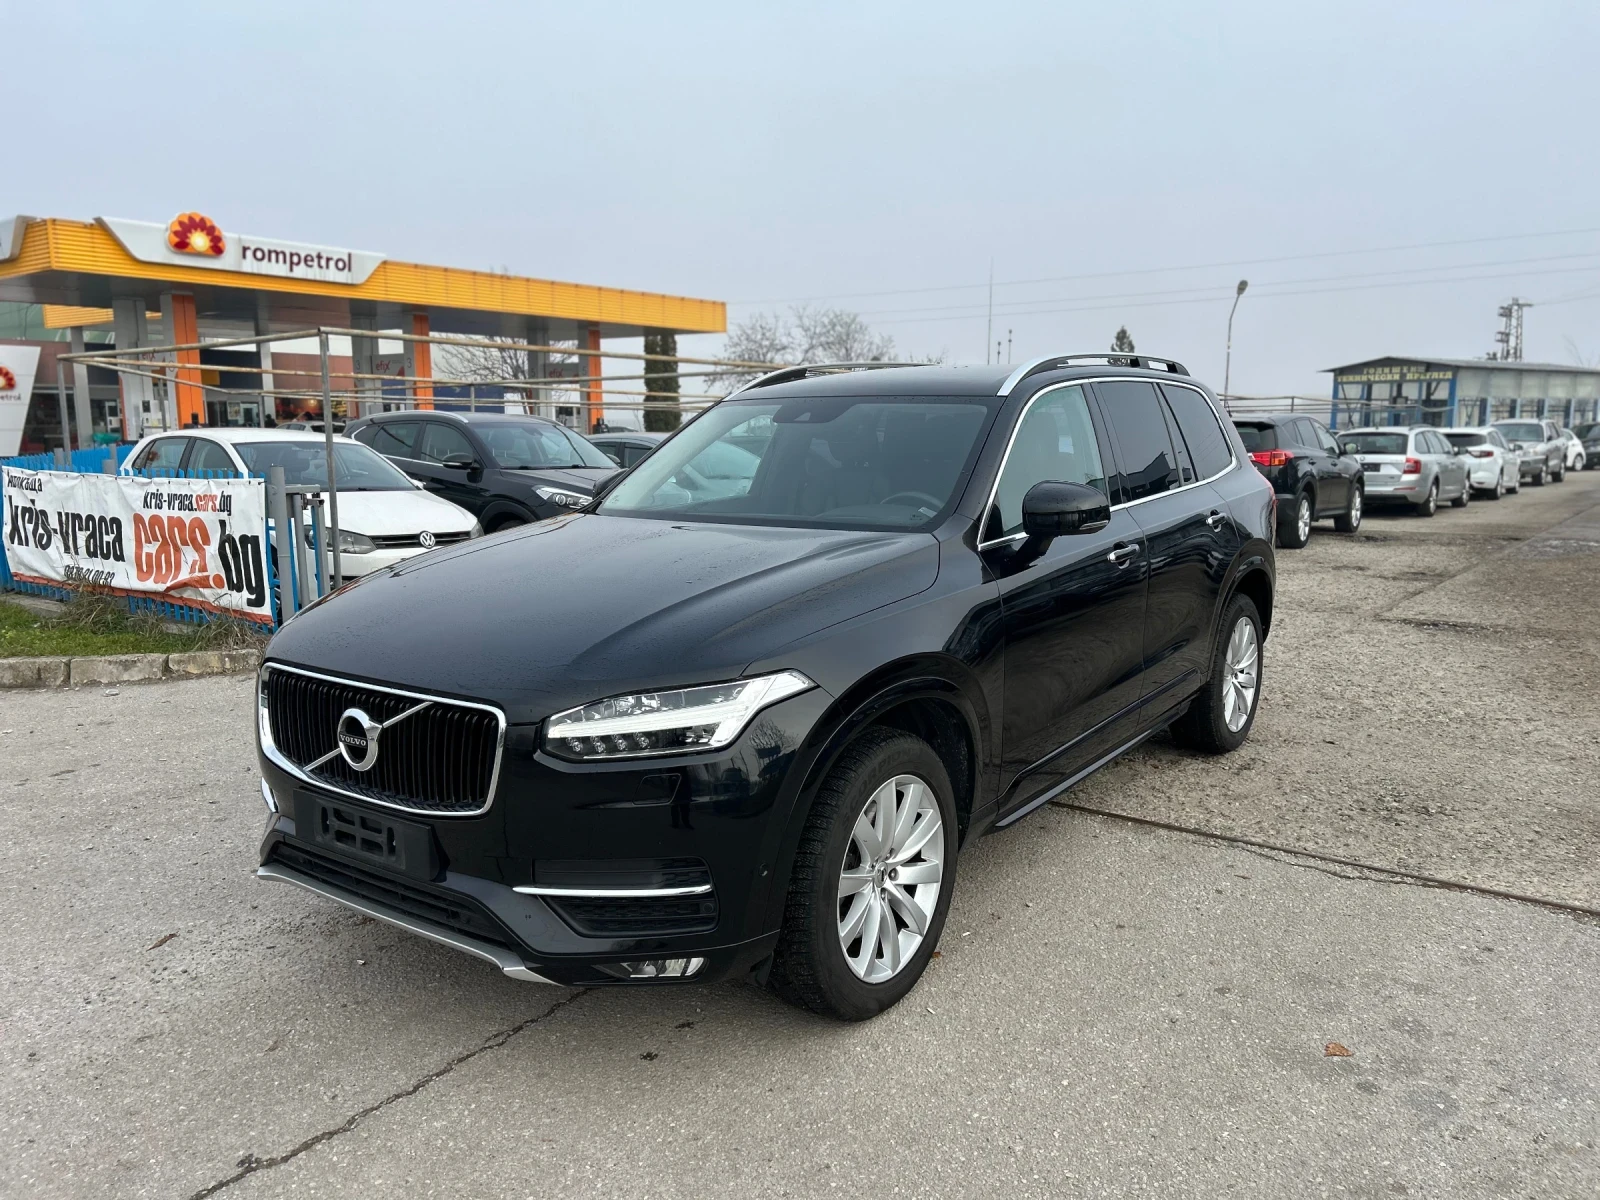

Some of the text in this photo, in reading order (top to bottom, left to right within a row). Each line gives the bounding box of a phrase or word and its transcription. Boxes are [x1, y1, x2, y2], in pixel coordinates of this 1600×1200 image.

[241, 245, 352, 273] rompetrol
[375, 360, 391, 373] efix
[1405, 371, 1453, 380] ПРЕГЛЕД
[143, 489, 232, 517] kris-vraca.cars.bg
[8, 495, 126, 563] kris-vraca
[340, 734, 367, 747] VOLVO
